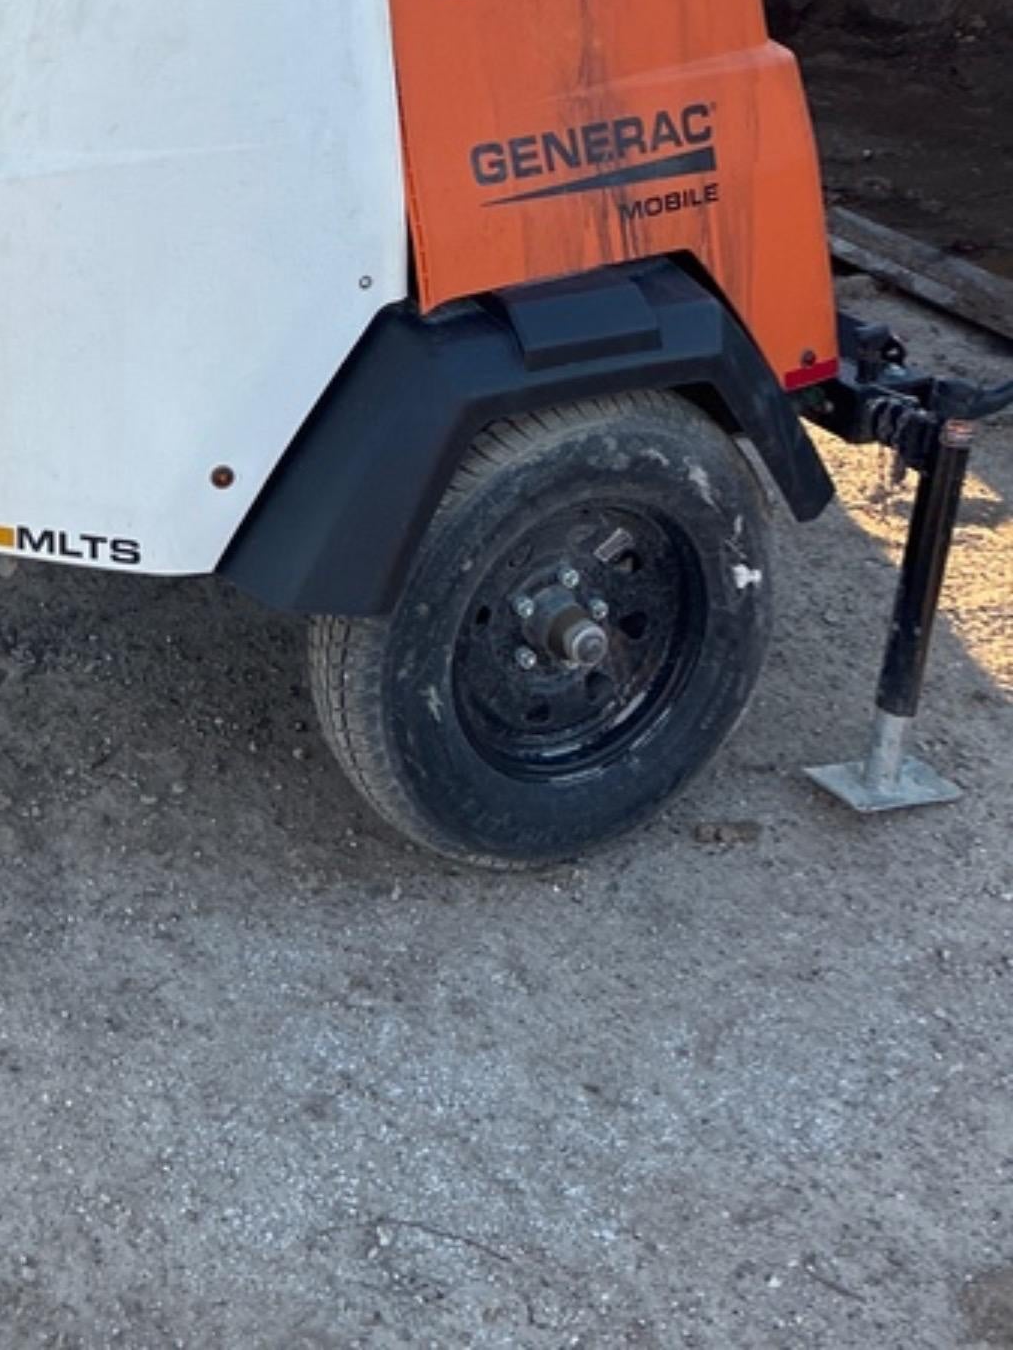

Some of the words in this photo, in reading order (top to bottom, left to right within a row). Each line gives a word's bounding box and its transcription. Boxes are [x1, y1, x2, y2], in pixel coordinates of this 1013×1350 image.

[470, 103, 713, 186] GENERAC
[618, 182, 719, 222] MOBILE
[16, 525, 141, 565] MLTS
